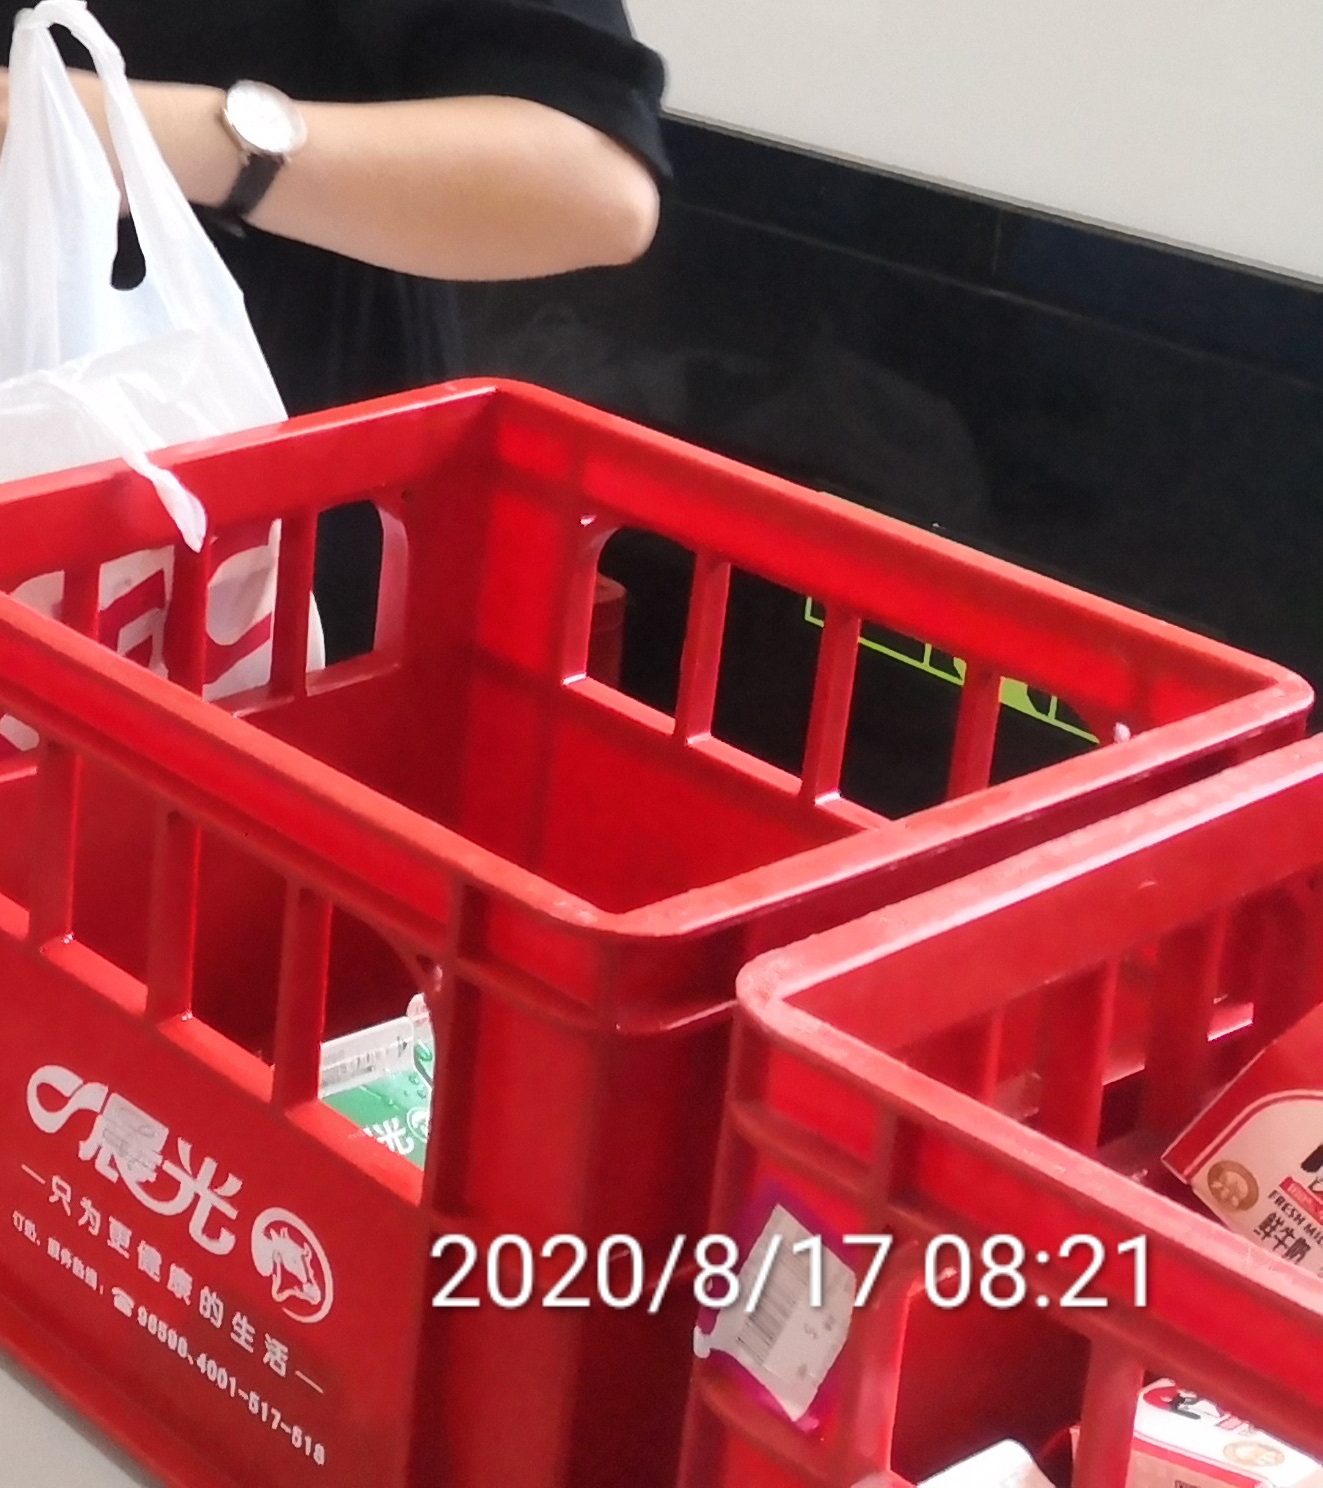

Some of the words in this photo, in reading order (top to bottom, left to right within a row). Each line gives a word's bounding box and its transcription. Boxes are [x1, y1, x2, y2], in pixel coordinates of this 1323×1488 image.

[28, 1065, 243, 1255] 晨光
[1268, 1189, 1306, 1227] FRESH
[47, 1174, 290, 1378] 只为更健康的生活
[1254, 1212, 1312, 1265] 鲜牛奶
